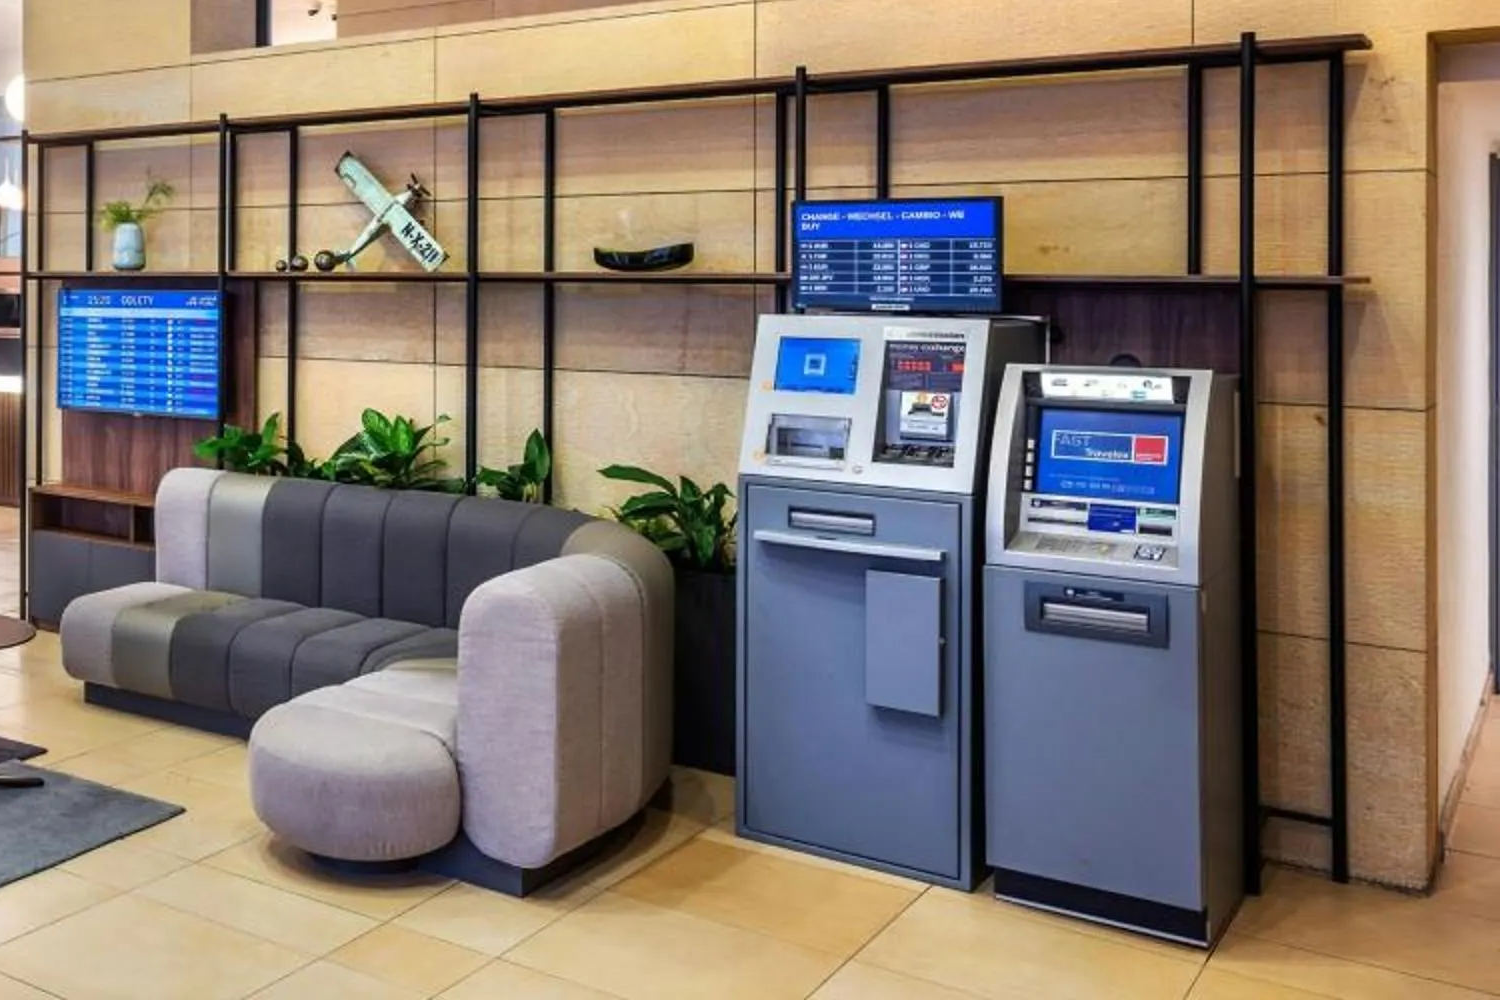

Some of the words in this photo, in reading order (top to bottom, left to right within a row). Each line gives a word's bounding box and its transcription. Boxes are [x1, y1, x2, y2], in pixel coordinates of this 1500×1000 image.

[801, 212, 840, 221] CHANGE
[901, 211, 940, 220] CAMBIO
[801, 222, 820, 231] BUY
